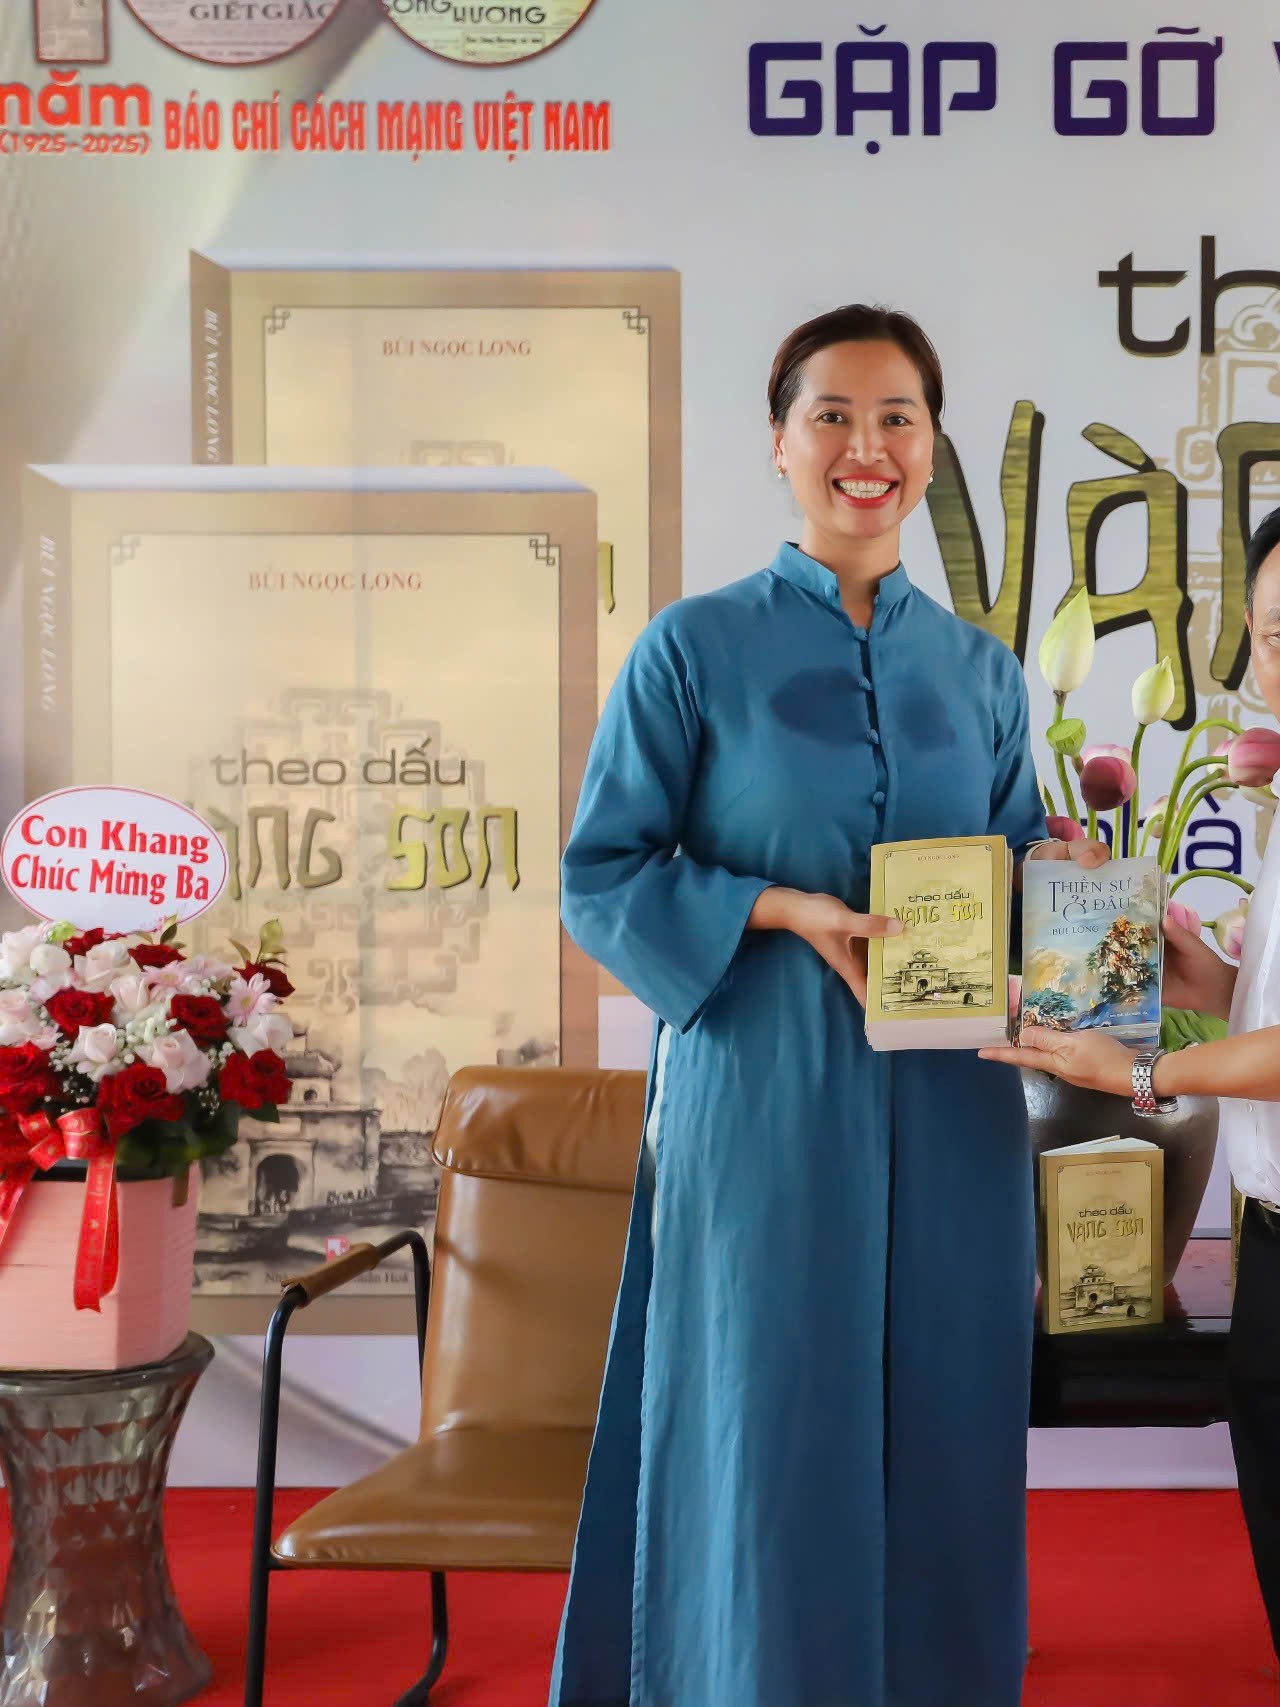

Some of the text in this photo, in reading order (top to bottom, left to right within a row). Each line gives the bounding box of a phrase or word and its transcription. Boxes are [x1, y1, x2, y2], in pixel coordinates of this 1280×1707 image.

[748, 24, 997, 155] GẶP
[1053, 26, 1223, 137] GỠ
[164, 90, 612, 162] BÁO CHÍ CÁCH MẠNG VIỆT NAM
[479, 339, 531, 356] LONG
[361, 571, 422, 591] LONG
[210, 738, 466, 785] theo dấu
[21, 814, 210, 864] Con Khang
[11, 853, 209, 905] Chúc Mừng Ba
[1094, 895, 1130, 911] ĐÂU
